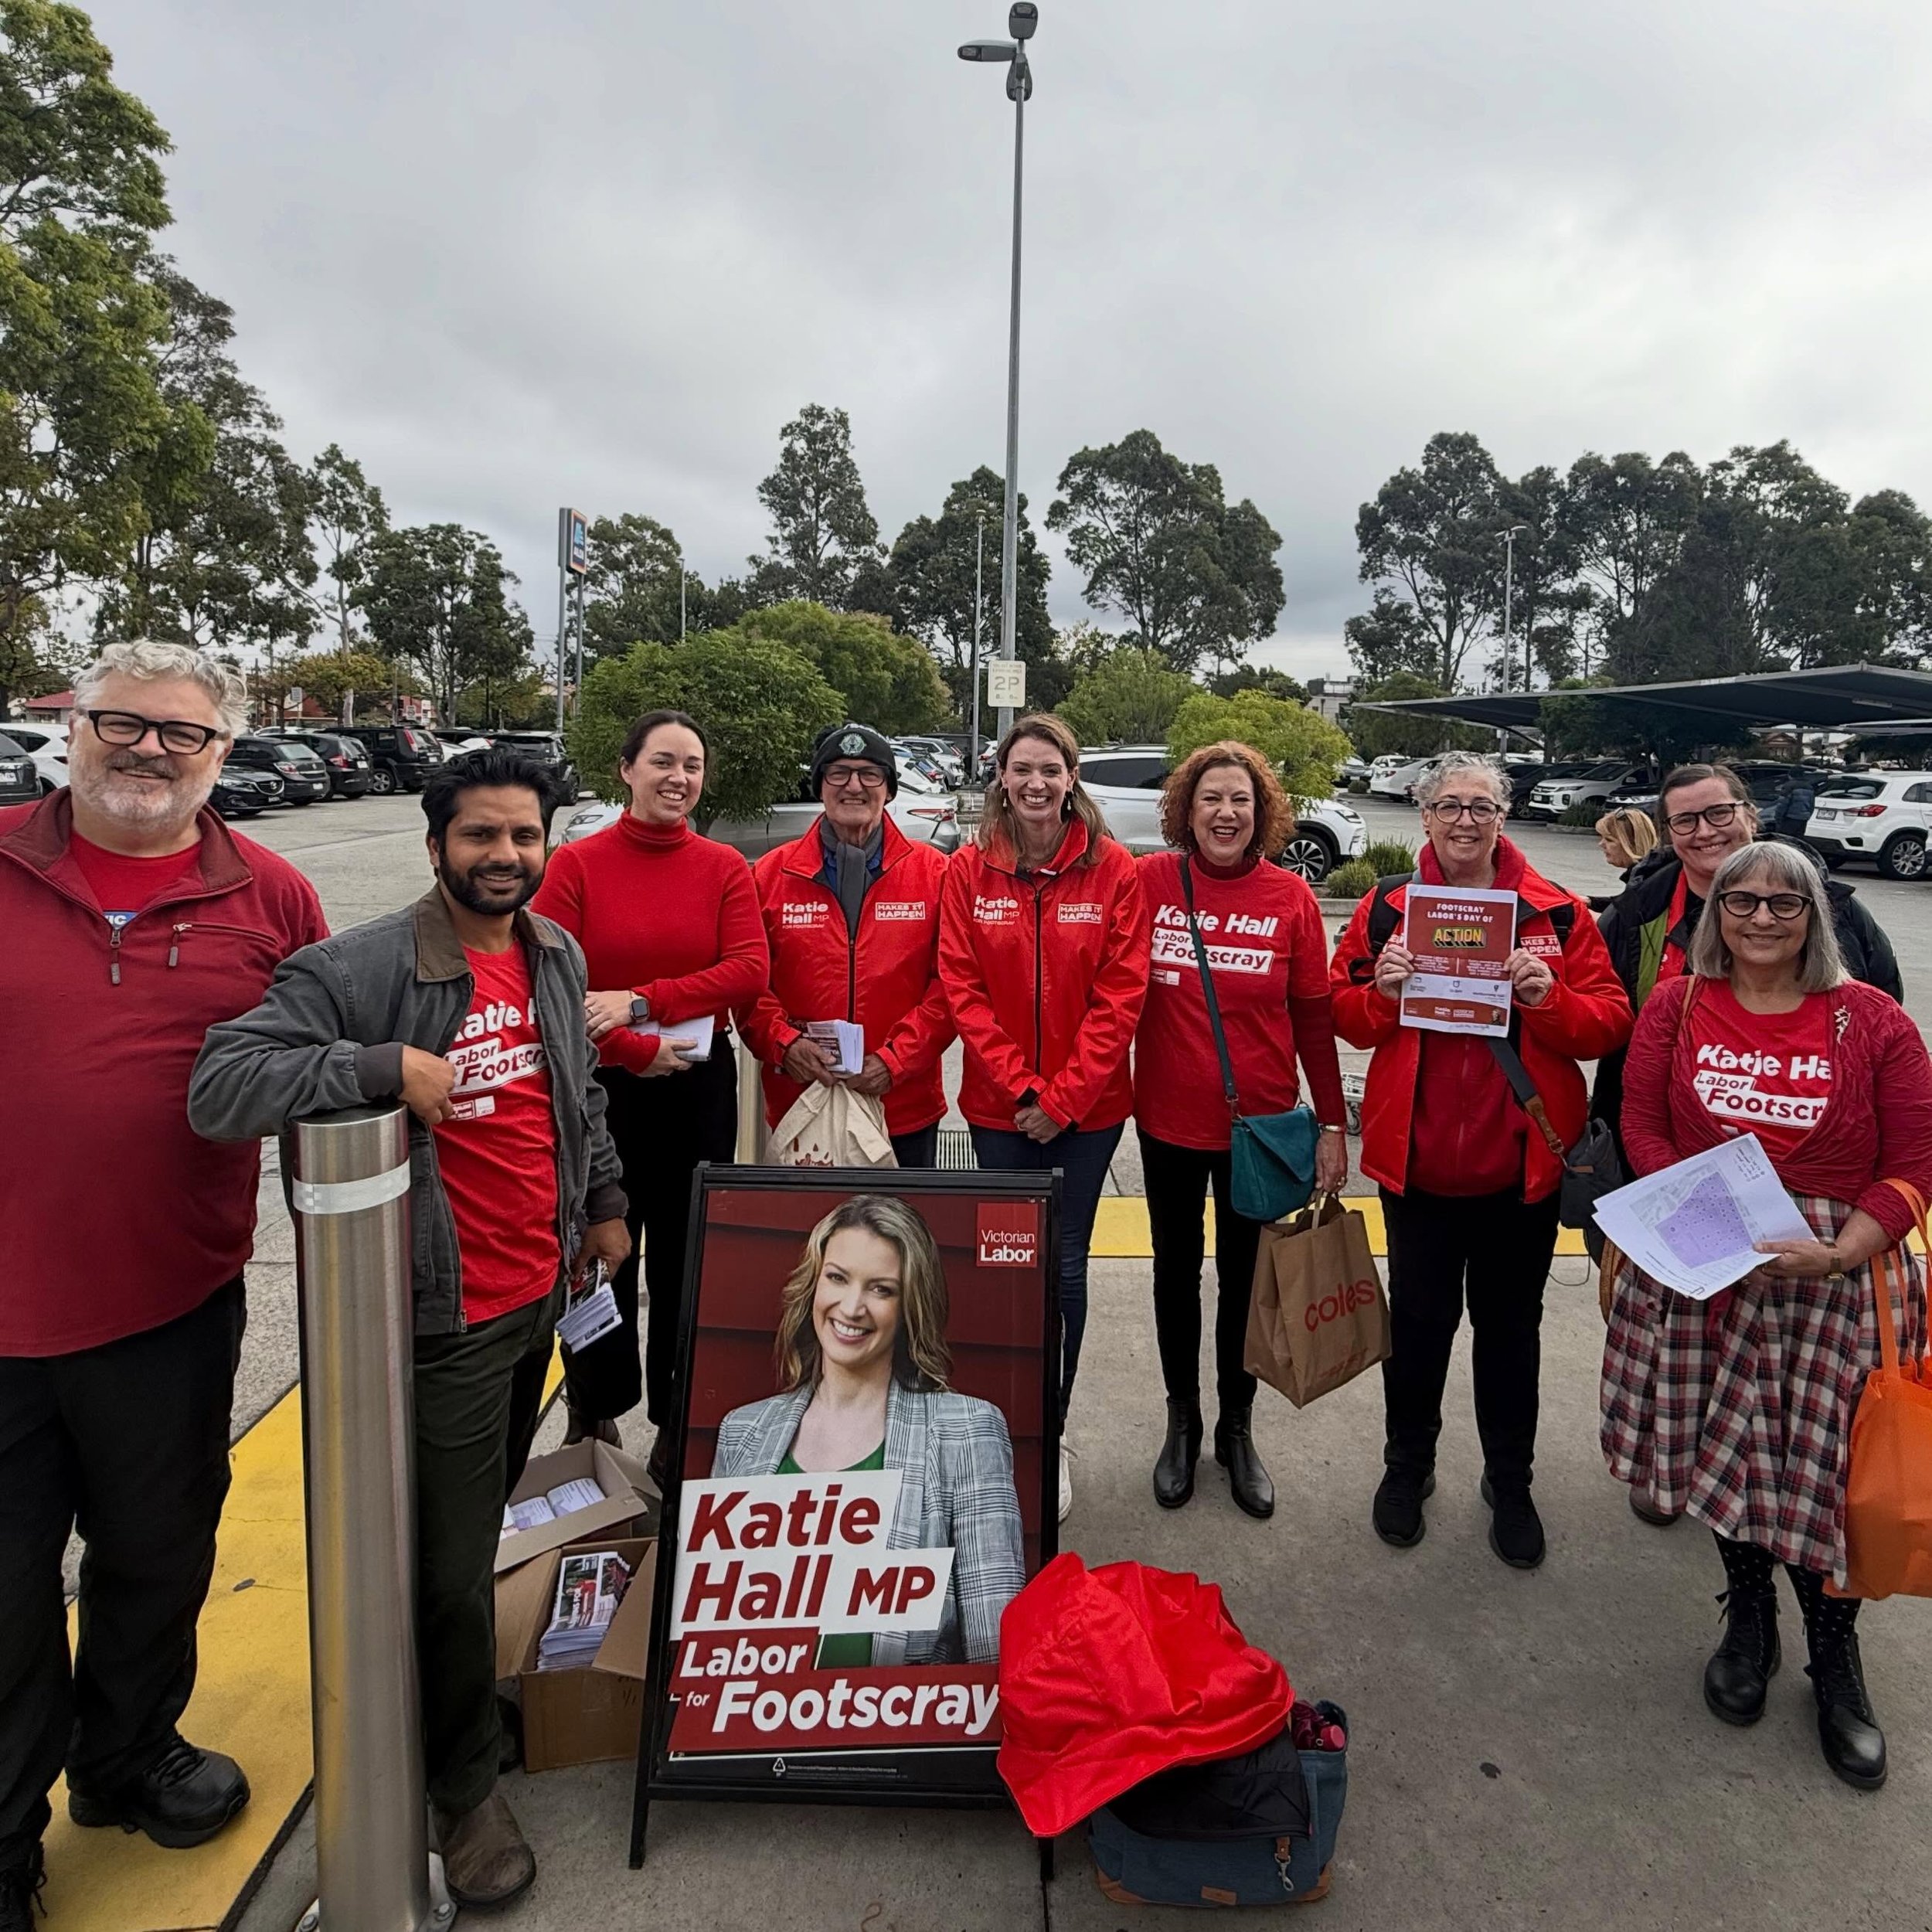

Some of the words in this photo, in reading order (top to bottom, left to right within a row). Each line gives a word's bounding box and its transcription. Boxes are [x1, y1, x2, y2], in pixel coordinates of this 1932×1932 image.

[995, 676, 1020, 690] 2P
[782, 901, 828, 913] Katie
[975, 895, 1019, 910] Katie
[1437, 903, 1485, 913] FOOTSCRAY
[104, 915, 128, 925] IC
[782, 913, 812, 924] Hall
[973, 906, 1003, 920] Hall
[1060, 913, 1101, 922] HAPPEN
[1427, 911, 1462, 921] LABOR'S
[1224, 913, 1279, 937] Hall
[1154, 930, 1190, 944] Labor
[1434, 928, 1482, 943] ACTION
[1160, 942, 1268, 969] Fooscray
[454, 1000, 522, 1042] atie
[445, 1044, 497, 1066] abor
[1696, 1044, 1782, 1077] Katie
[1696, 1073, 1750, 1091] Labor
[981, 1229, 1036, 1243] Victorian
[980, 1244, 1035, 1262] Labor
[1304, 1279, 1376, 1333] coles
[685, 1484, 880, 1553] Katie
[681, 1553, 834, 1623] Hall
[845, 1565, 936, 1617] MP
[679, 1638, 808, 1678] Labor
[685, 1690, 709, 1707] for
[711, 1679, 1000, 1736] Footscray
